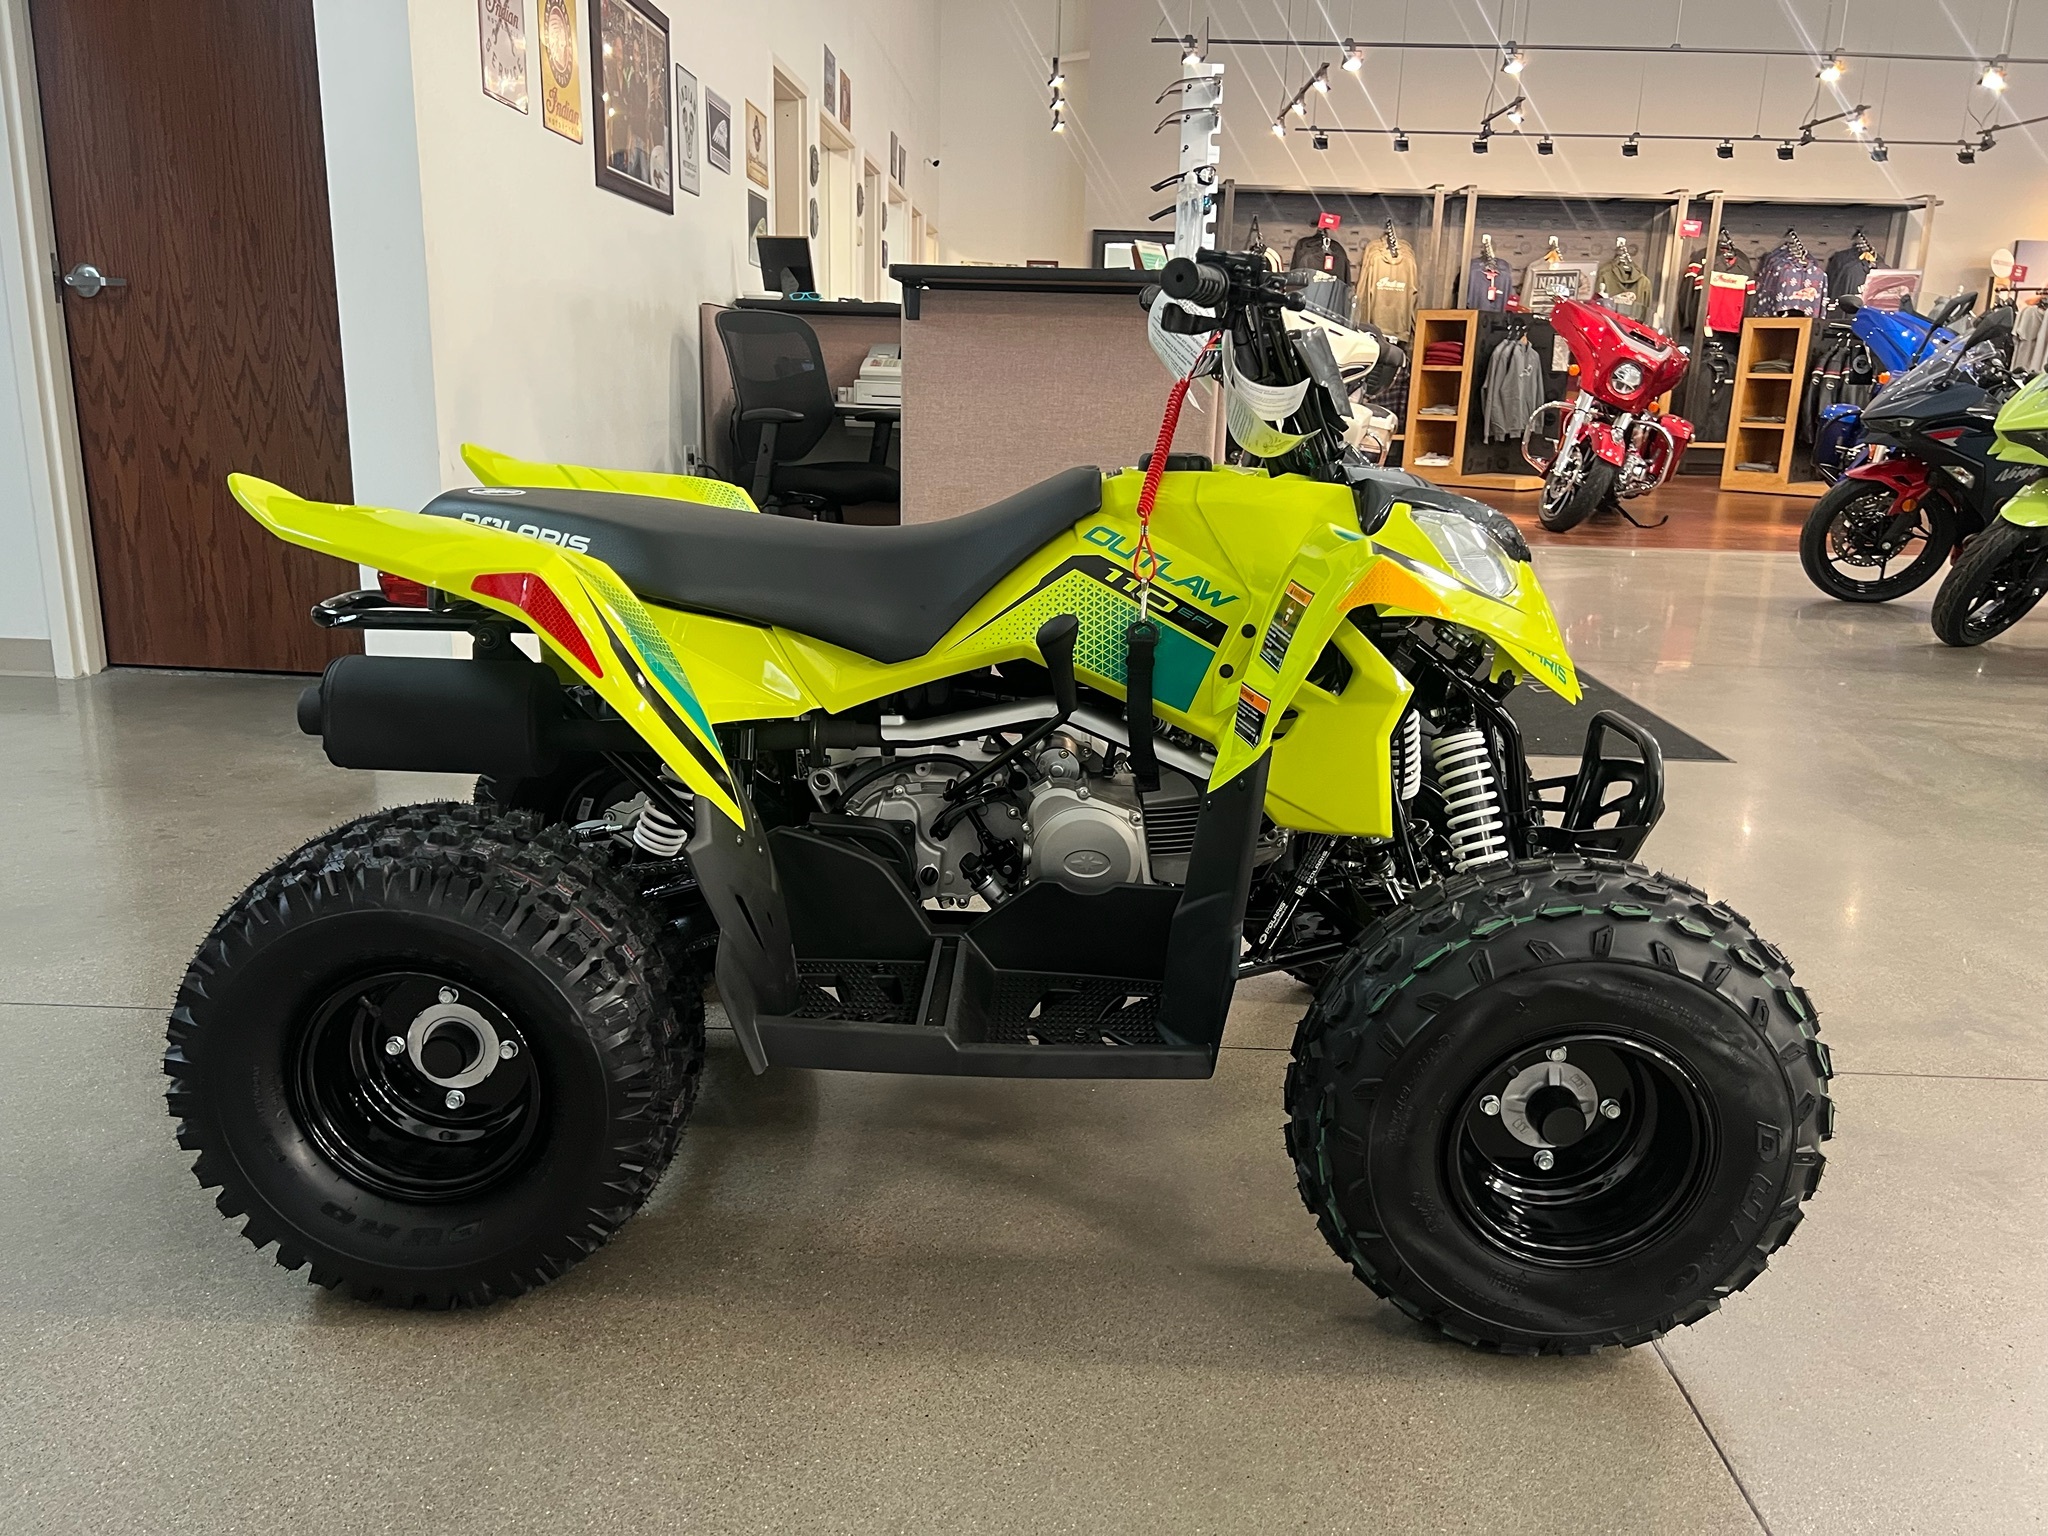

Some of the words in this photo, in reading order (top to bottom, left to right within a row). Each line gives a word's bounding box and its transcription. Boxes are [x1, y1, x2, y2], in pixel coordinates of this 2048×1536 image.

[545, 86, 580, 125] Indian
[1534, 275, 1577, 290] INDIAN
[1082, 526, 1240, 608] OUTLAW
[1104, 567, 1179, 613] 110
[1177, 606, 1214, 630] EFI
[1265, 900, 1287, 935] POLARIS
